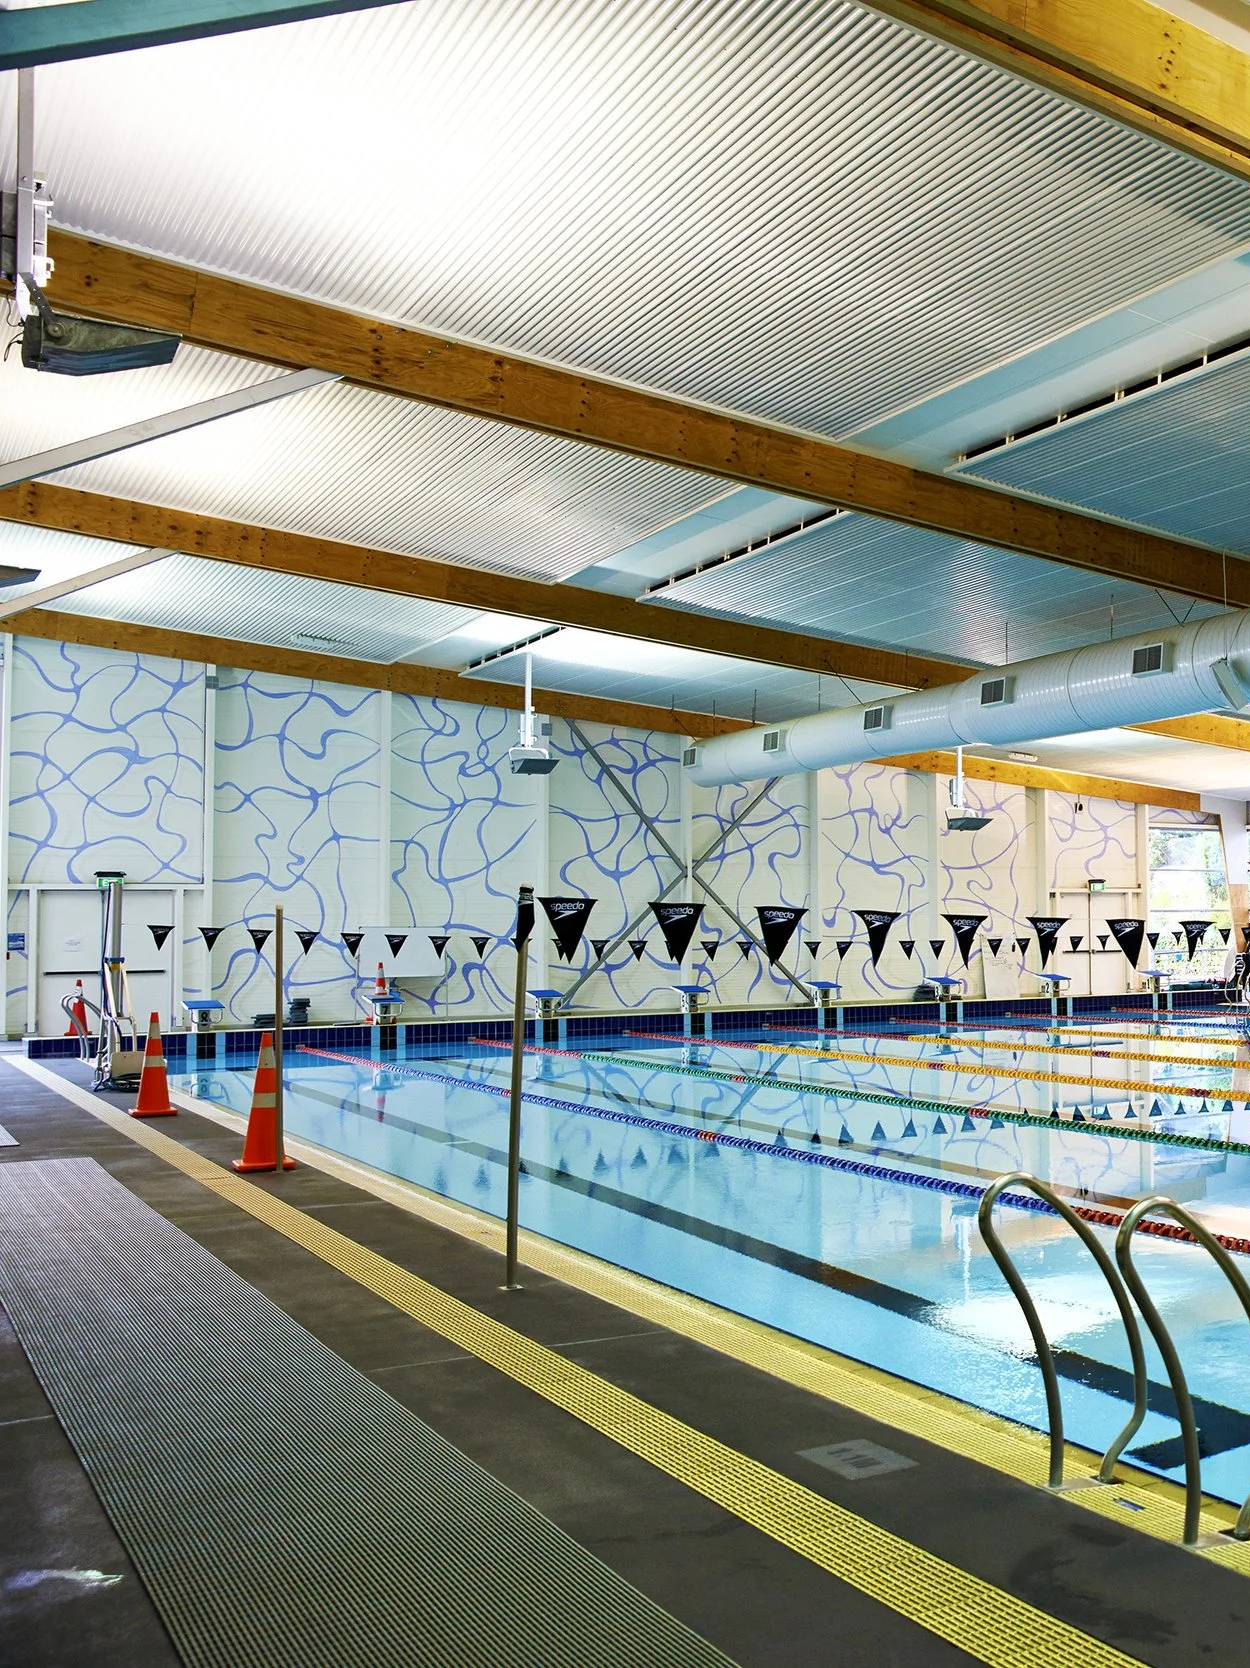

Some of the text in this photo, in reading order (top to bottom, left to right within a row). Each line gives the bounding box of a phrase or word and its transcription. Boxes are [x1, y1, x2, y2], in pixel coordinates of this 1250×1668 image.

[550, 902, 585, 911] speedo
[660, 906, 694, 916] speedo
[764, 910, 796, 920] speedo
[863, 913, 892, 924] speedo
[952, 918, 979, 927] speedo
[1036, 921, 1061, 930] speedo
[1114, 921, 1139, 930] speedo
[1046, 982, 1050, 994] 2
[690, 995, 697, 1007] 5
[544, 1000, 551, 1013] 6
[382, 1006, 389, 1019] 7
[201, 1012, 208, 1026] 8
